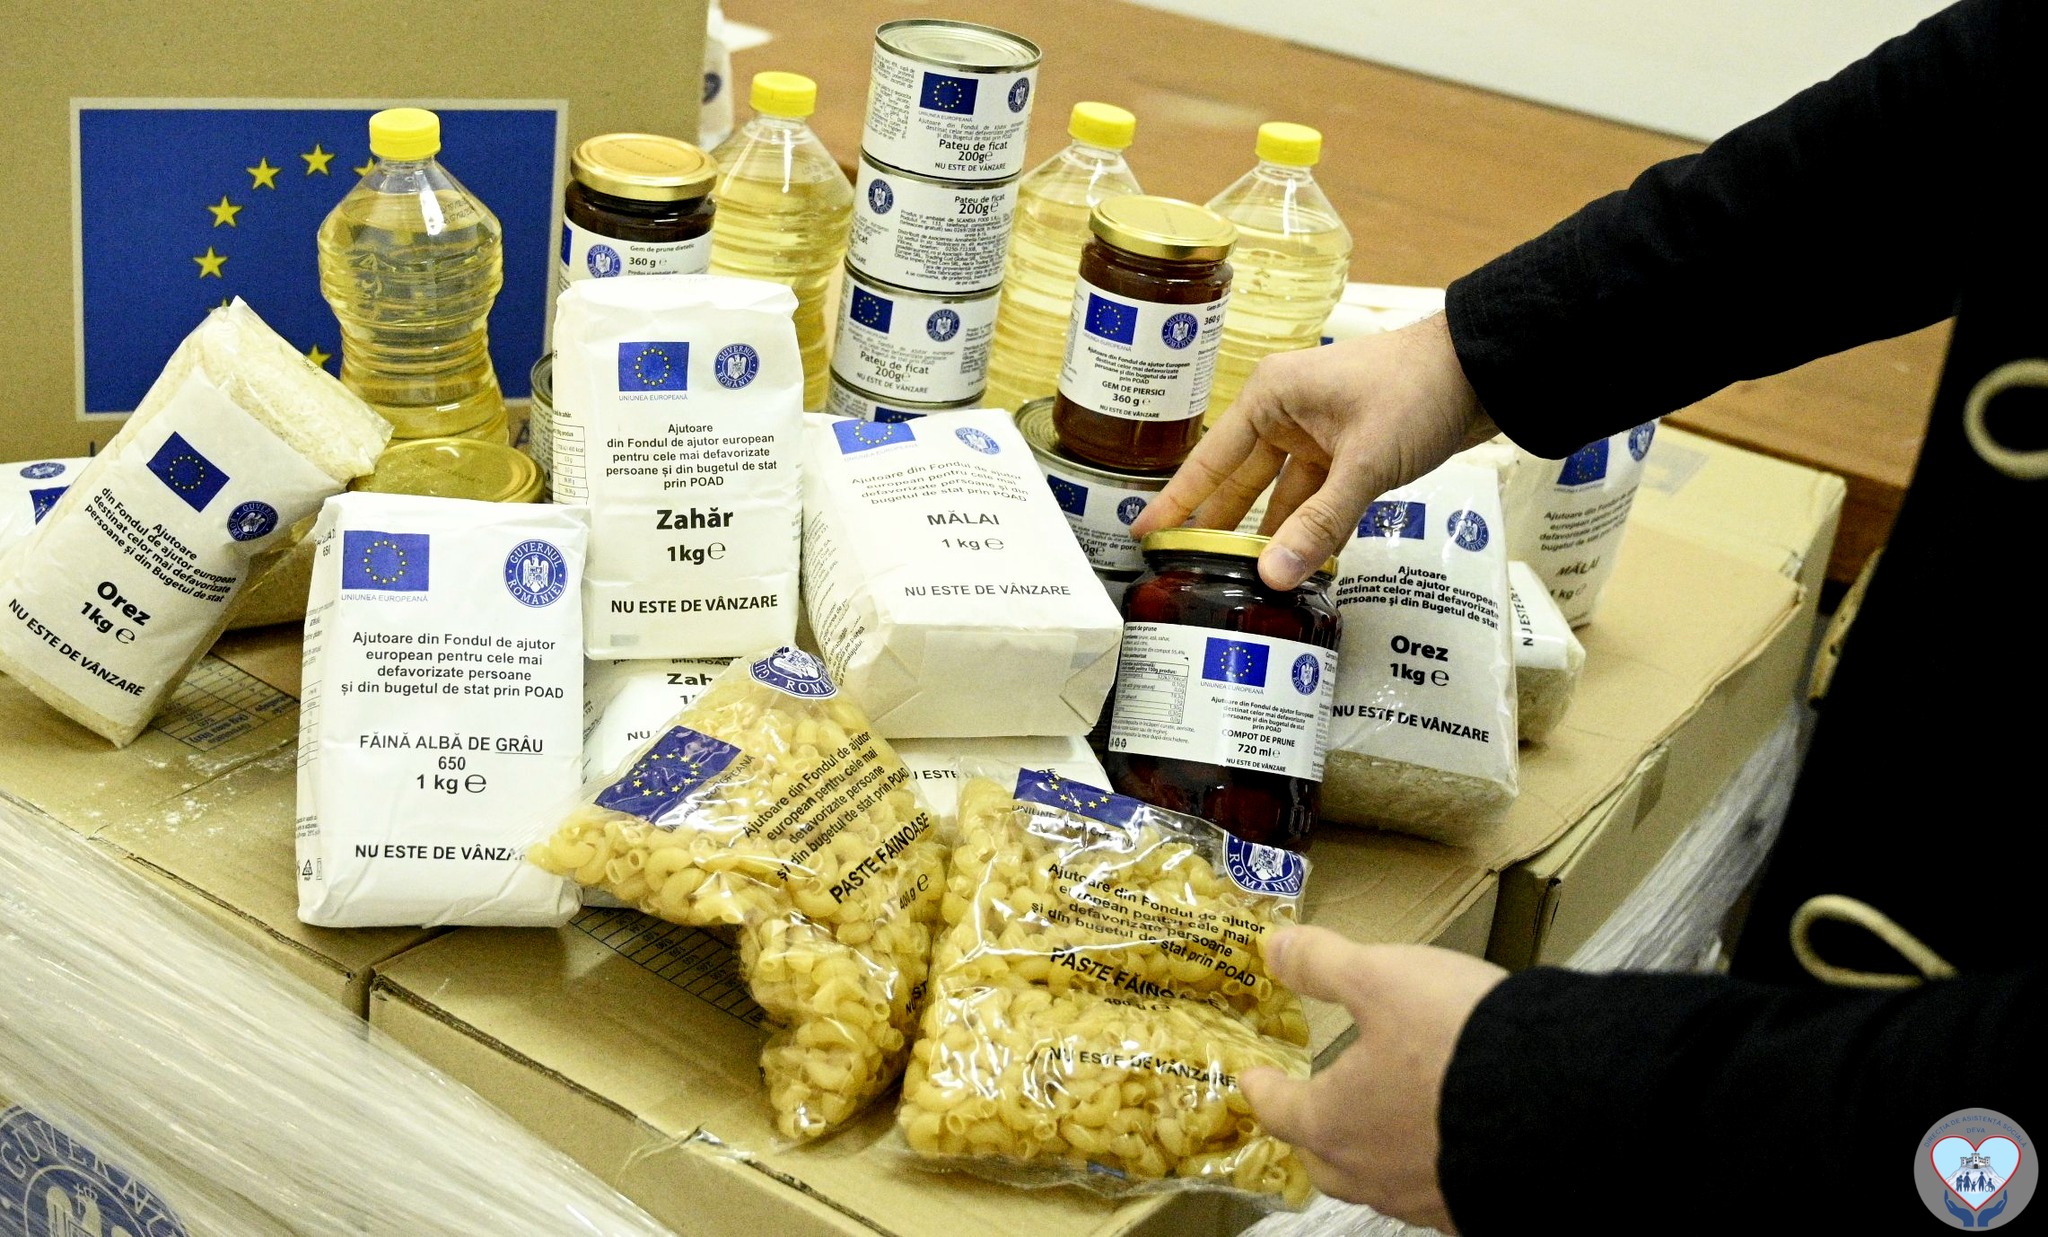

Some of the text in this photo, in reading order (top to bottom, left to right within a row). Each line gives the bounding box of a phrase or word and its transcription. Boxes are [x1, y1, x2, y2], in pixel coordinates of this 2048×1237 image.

[939, 139, 1007, 151] Pateu de ficat
[955, 195, 978, 203] Pateu
[992, 194, 1005, 202] ficat
[629, 257, 656, 268] 360 g
[860, 351, 929, 374] Pateu de ficat
[1102, 380, 1165, 395] GEM DE PIERSICI
[1112, 393, 1139, 407] 360 g
[1109, 406, 1122, 414] ESTE
[1133, 410, 1159, 418] VÂNZARE
[668, 424, 713, 434] Ajutoare
[607, 434, 775, 448] din Fondul de ajutor european
[613, 448, 770, 462] pentru cele mai defavorizate
[606, 466, 658, 477] persoane
[676, 464, 693, 474] din
[697, 463, 739, 475] bugetul
[742, 461, 755, 471] de
[758, 461, 777, 470] stat
[664, 476, 724, 490] prin POAD
[657, 507, 733, 530] Zahăr
[927, 511, 1000, 526] MĂLAI
[941, 537, 980, 551] 1 kg
[510, 542, 561, 567] GUVERNUL
[341, 593, 428, 602] UNIUNEA EUROPEANĂ
[905, 583, 1071, 597] NU ESTE DE VÂNZARE
[96, 580, 152, 627] Orez
[612, 595, 778, 613] NU ESTE DE VÂNZARE
[8, 598, 145, 698] NU ESTE DE VÂNZARE
[353, 632, 555, 652] Ajutoare din Fondul de ajutor
[1390, 635, 1449, 662] Orez
[366, 650, 543, 665] european pentru cele mai
[377, 665, 531, 682] defavorizate persoane
[358, 682, 379, 693] din
[384, 682, 438, 696] bugetul
[443, 683, 459, 695] de
[464, 684, 489, 695] stat
[494, 685, 519, 697] prin
[525, 686, 564, 699] POAD
[1332, 705, 1490, 743] NU ESTE DE VÂNZARE
[360, 731, 543, 753] FĂINĂ ALBĂ DE GRÂU
[1222, 729, 1295, 747] COMPOT DE PRUNE
[1238, 743, 1272, 757] 720 ml
[438, 756, 466, 771] 650
[1237, 759, 1251, 767] ESTE
[1262, 763, 1286, 772] VÂNZARE
[417, 774, 458, 794] 1 kg
[355, 845, 378, 857] NU
[384, 845, 427, 859] ESTE
[433, 847, 456, 860] DE
[829, 812, 930, 904] PASTE FĂINOASE
[1050, 947, 1113, 981] PASTE
